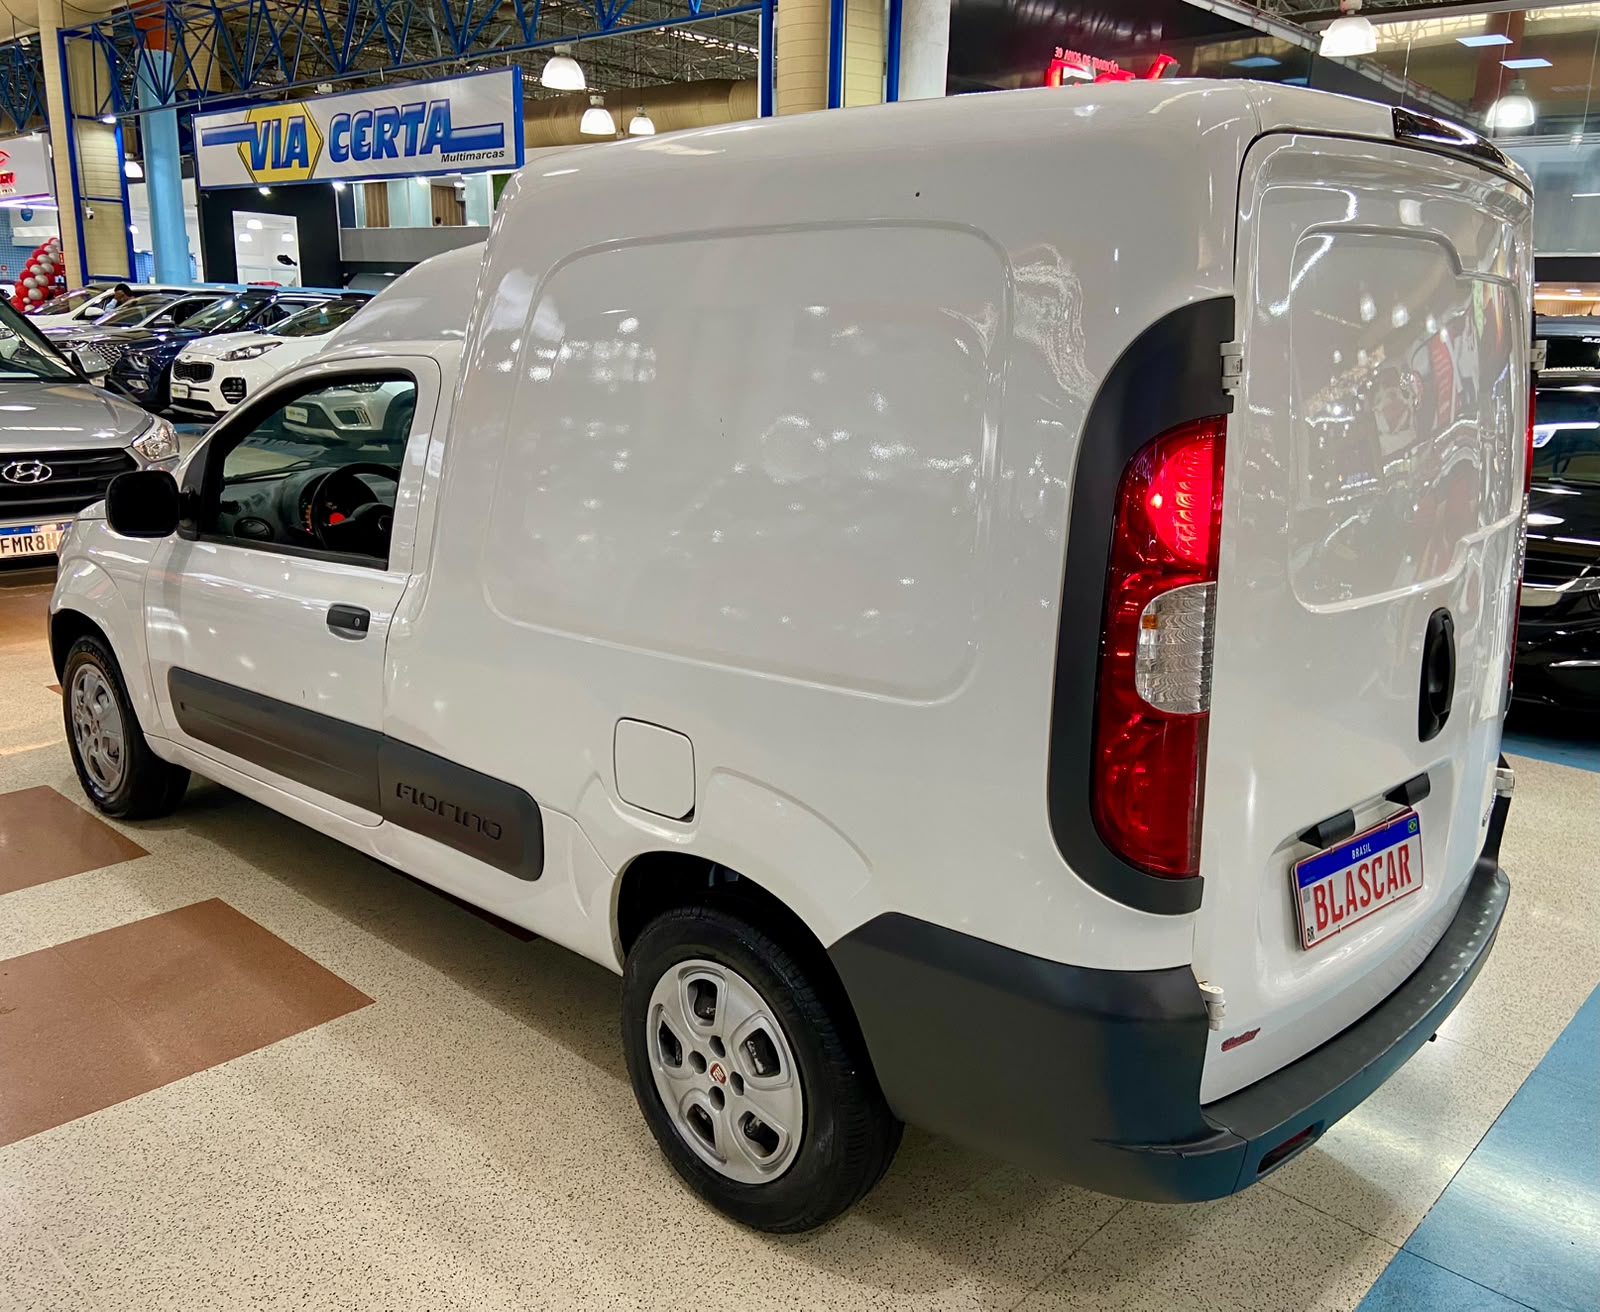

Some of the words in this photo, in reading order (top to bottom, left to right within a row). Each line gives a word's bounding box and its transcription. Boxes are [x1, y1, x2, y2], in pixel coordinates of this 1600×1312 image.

[1064, 49, 1081, 64] ANOS
[1082, 54, 1091, 66] DE
[241, 115, 309, 171] VIA
[329, 99, 453, 163] CERTA
[440, 150, 505, 163] Multimarcas
[1351, 843, 1372, 859] BRASIL
[1313, 843, 1412, 931] BLASCAR
[1306, 926, 1316, 942] BR
